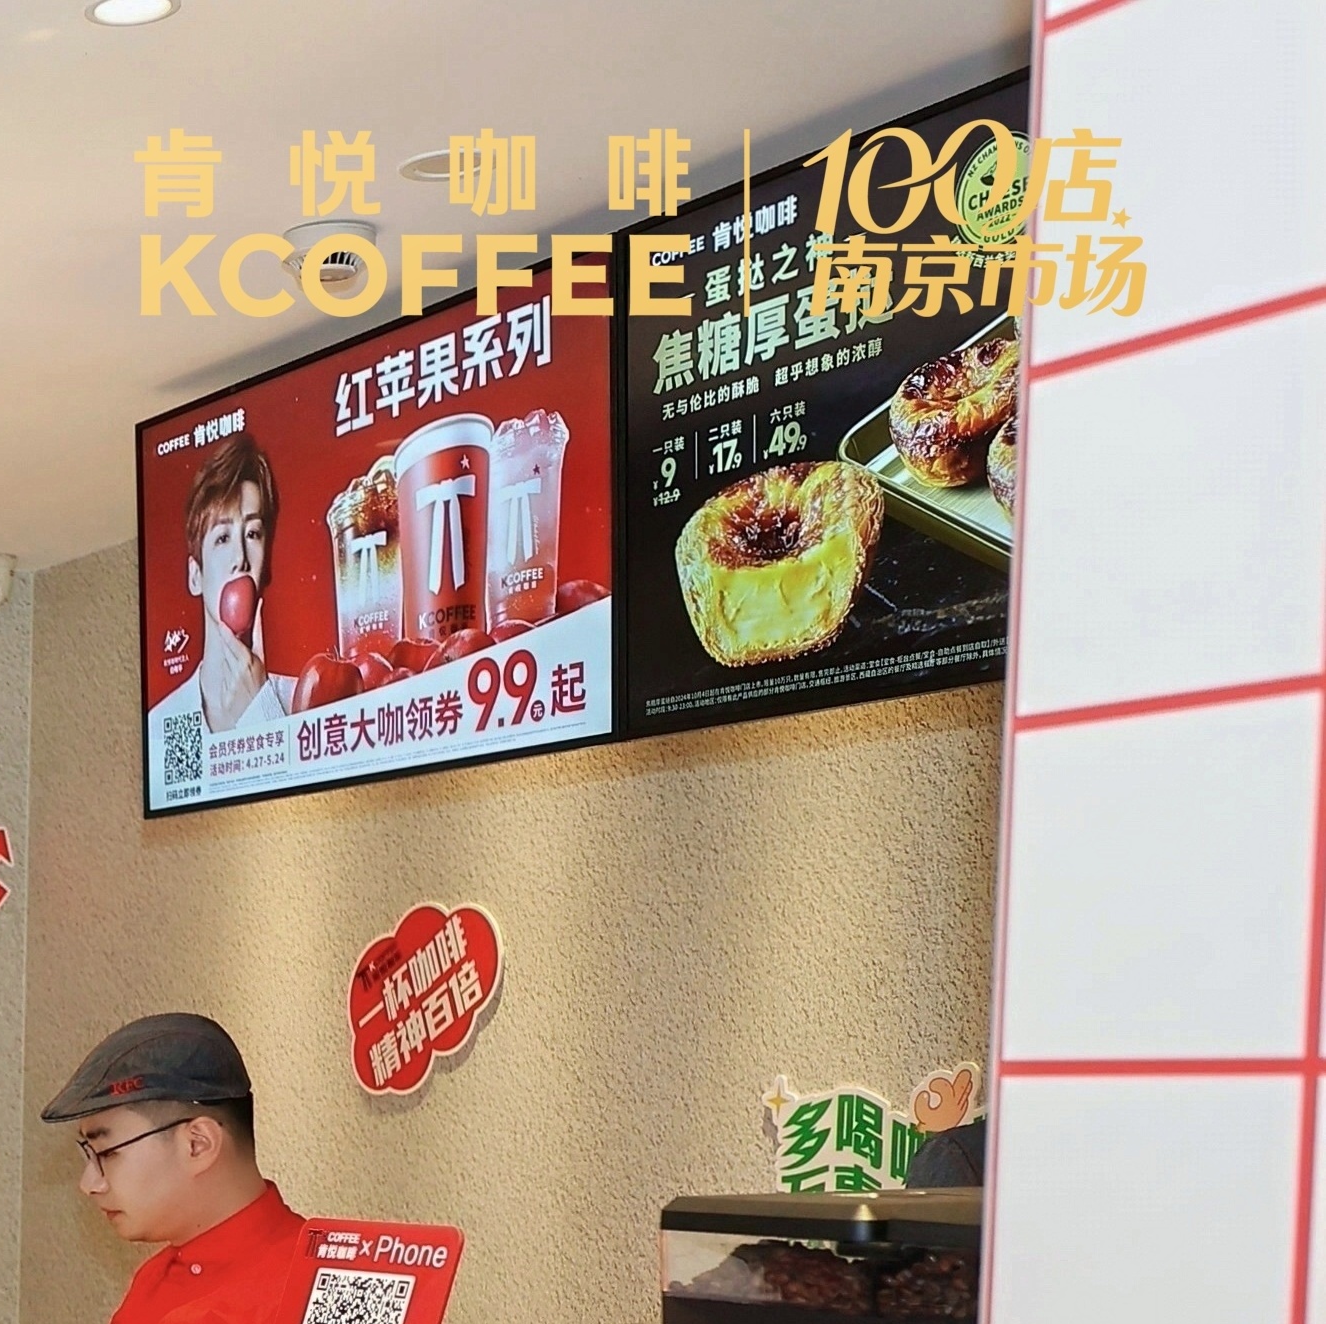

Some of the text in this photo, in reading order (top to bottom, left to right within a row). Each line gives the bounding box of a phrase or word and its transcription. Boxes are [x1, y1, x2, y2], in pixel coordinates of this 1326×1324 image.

[335, 296, 552, 437] 红苹果系列
[662, 337, 883, 421] 无与伦比的酥脆 超乎想象的浓醇
[194, 407, 247, 448] 肯悦咖啡
[770, 401, 806, 424] 六只装
[652, 436, 685, 456] 一只装
[708, 419, 742, 442] 二只装
[418, 604, 477, 630] KCOFFEE
[209, 730, 285, 760] 会员凭券堂食专享
[358, 913, 468, 1029] 一杯咖啡
[369, 958, 483, 1087] 精神百倍
[109, 1076, 144, 1096] KFC
[316, 1243, 357, 1261] 肯悦咖啡
[373, 1235, 448, 1268] Phone
